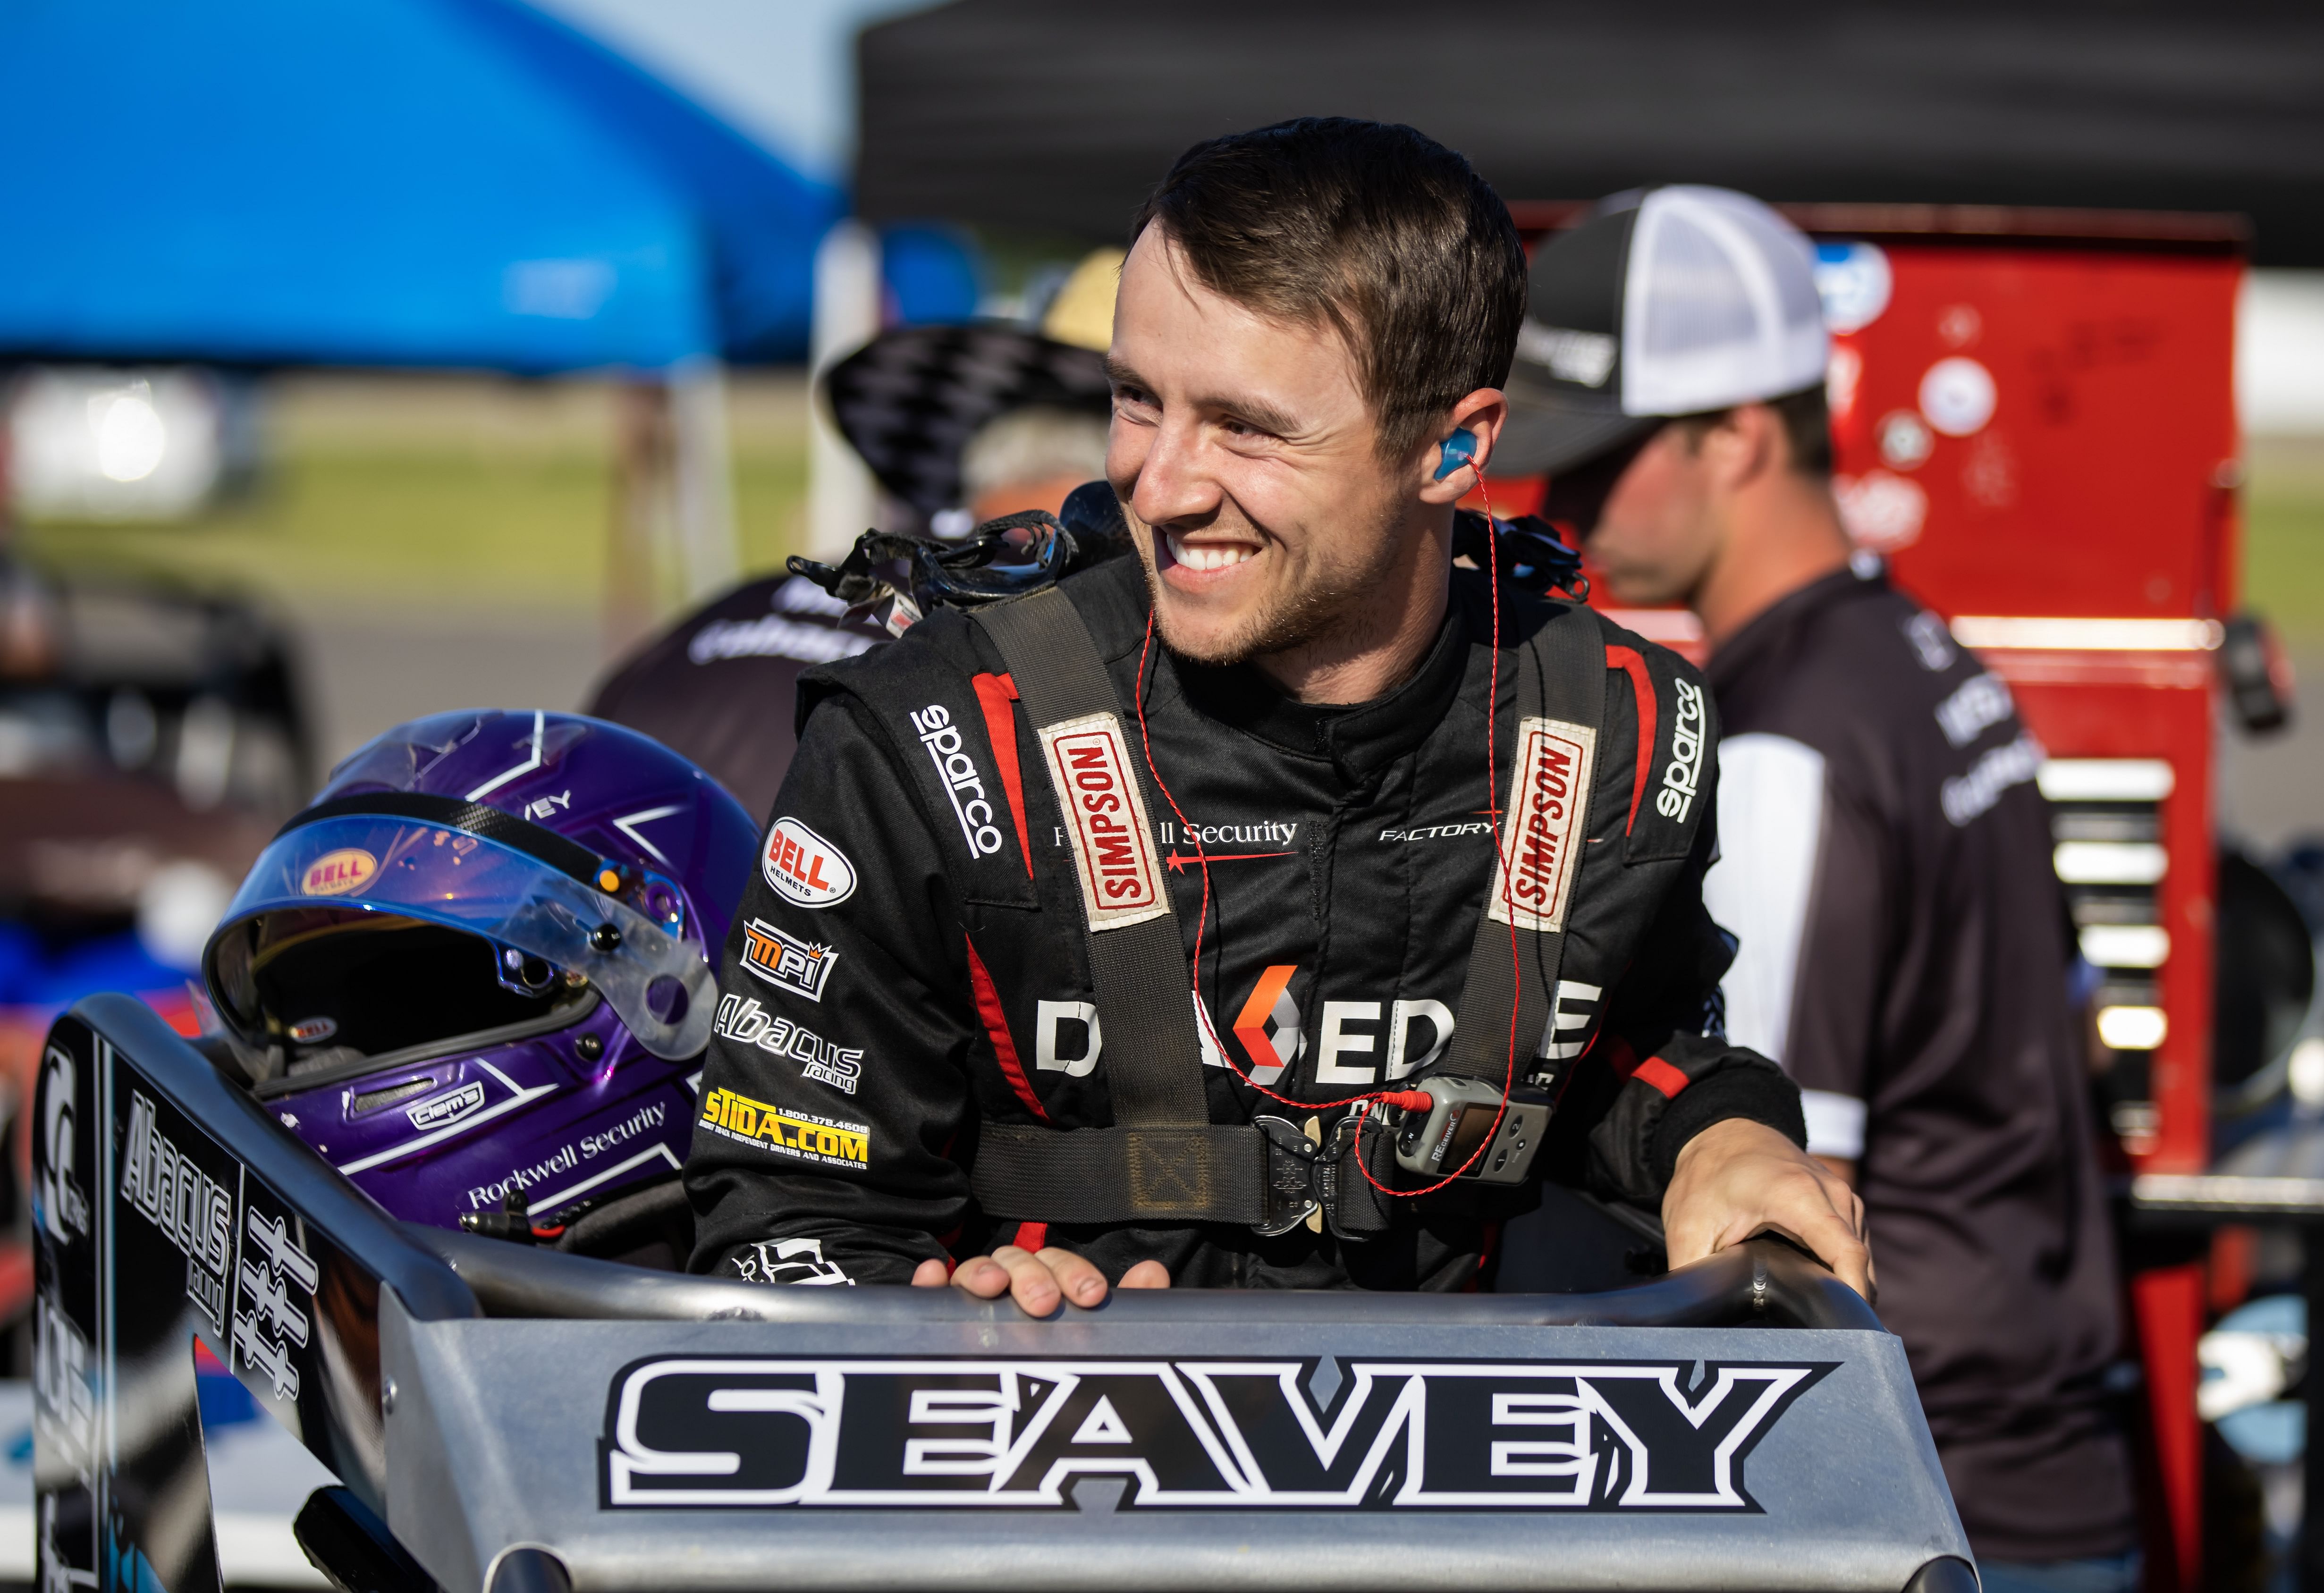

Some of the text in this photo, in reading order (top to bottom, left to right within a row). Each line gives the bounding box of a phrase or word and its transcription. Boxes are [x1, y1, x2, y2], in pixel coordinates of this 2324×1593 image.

[917, 705, 1002, 854] sparco
[1656, 678, 1702, 819] sparco
[768, 828, 829, 891] BELL
[1067, 747, 1142, 899] SIMPSON
[1183, 820, 1297, 845] Security
[1378, 822, 1501, 842] FACTORY
[1515, 745, 1571, 906] SIMPSON
[770, 865, 811, 897] HELMETS
[714, 993, 864, 1079] Abacus
[415, 1089, 479, 1124] Clem's
[802, 1062, 857, 1094] racing
[467, 1101, 666, 1209] Rockwell Security
[702, 1087, 868, 1163] STIDA.COM
[770, 1144, 801, 1157] DRIVERS
[803, 1152, 819, 1162] AND
[821, 1155, 867, 1170] ASSOCIATES
[778, 1108, 869, 1134] 1.800.378.4608
[120, 1088, 231, 1280] Abacus
[607, 1358, 1815, 1508] SEAVEY
